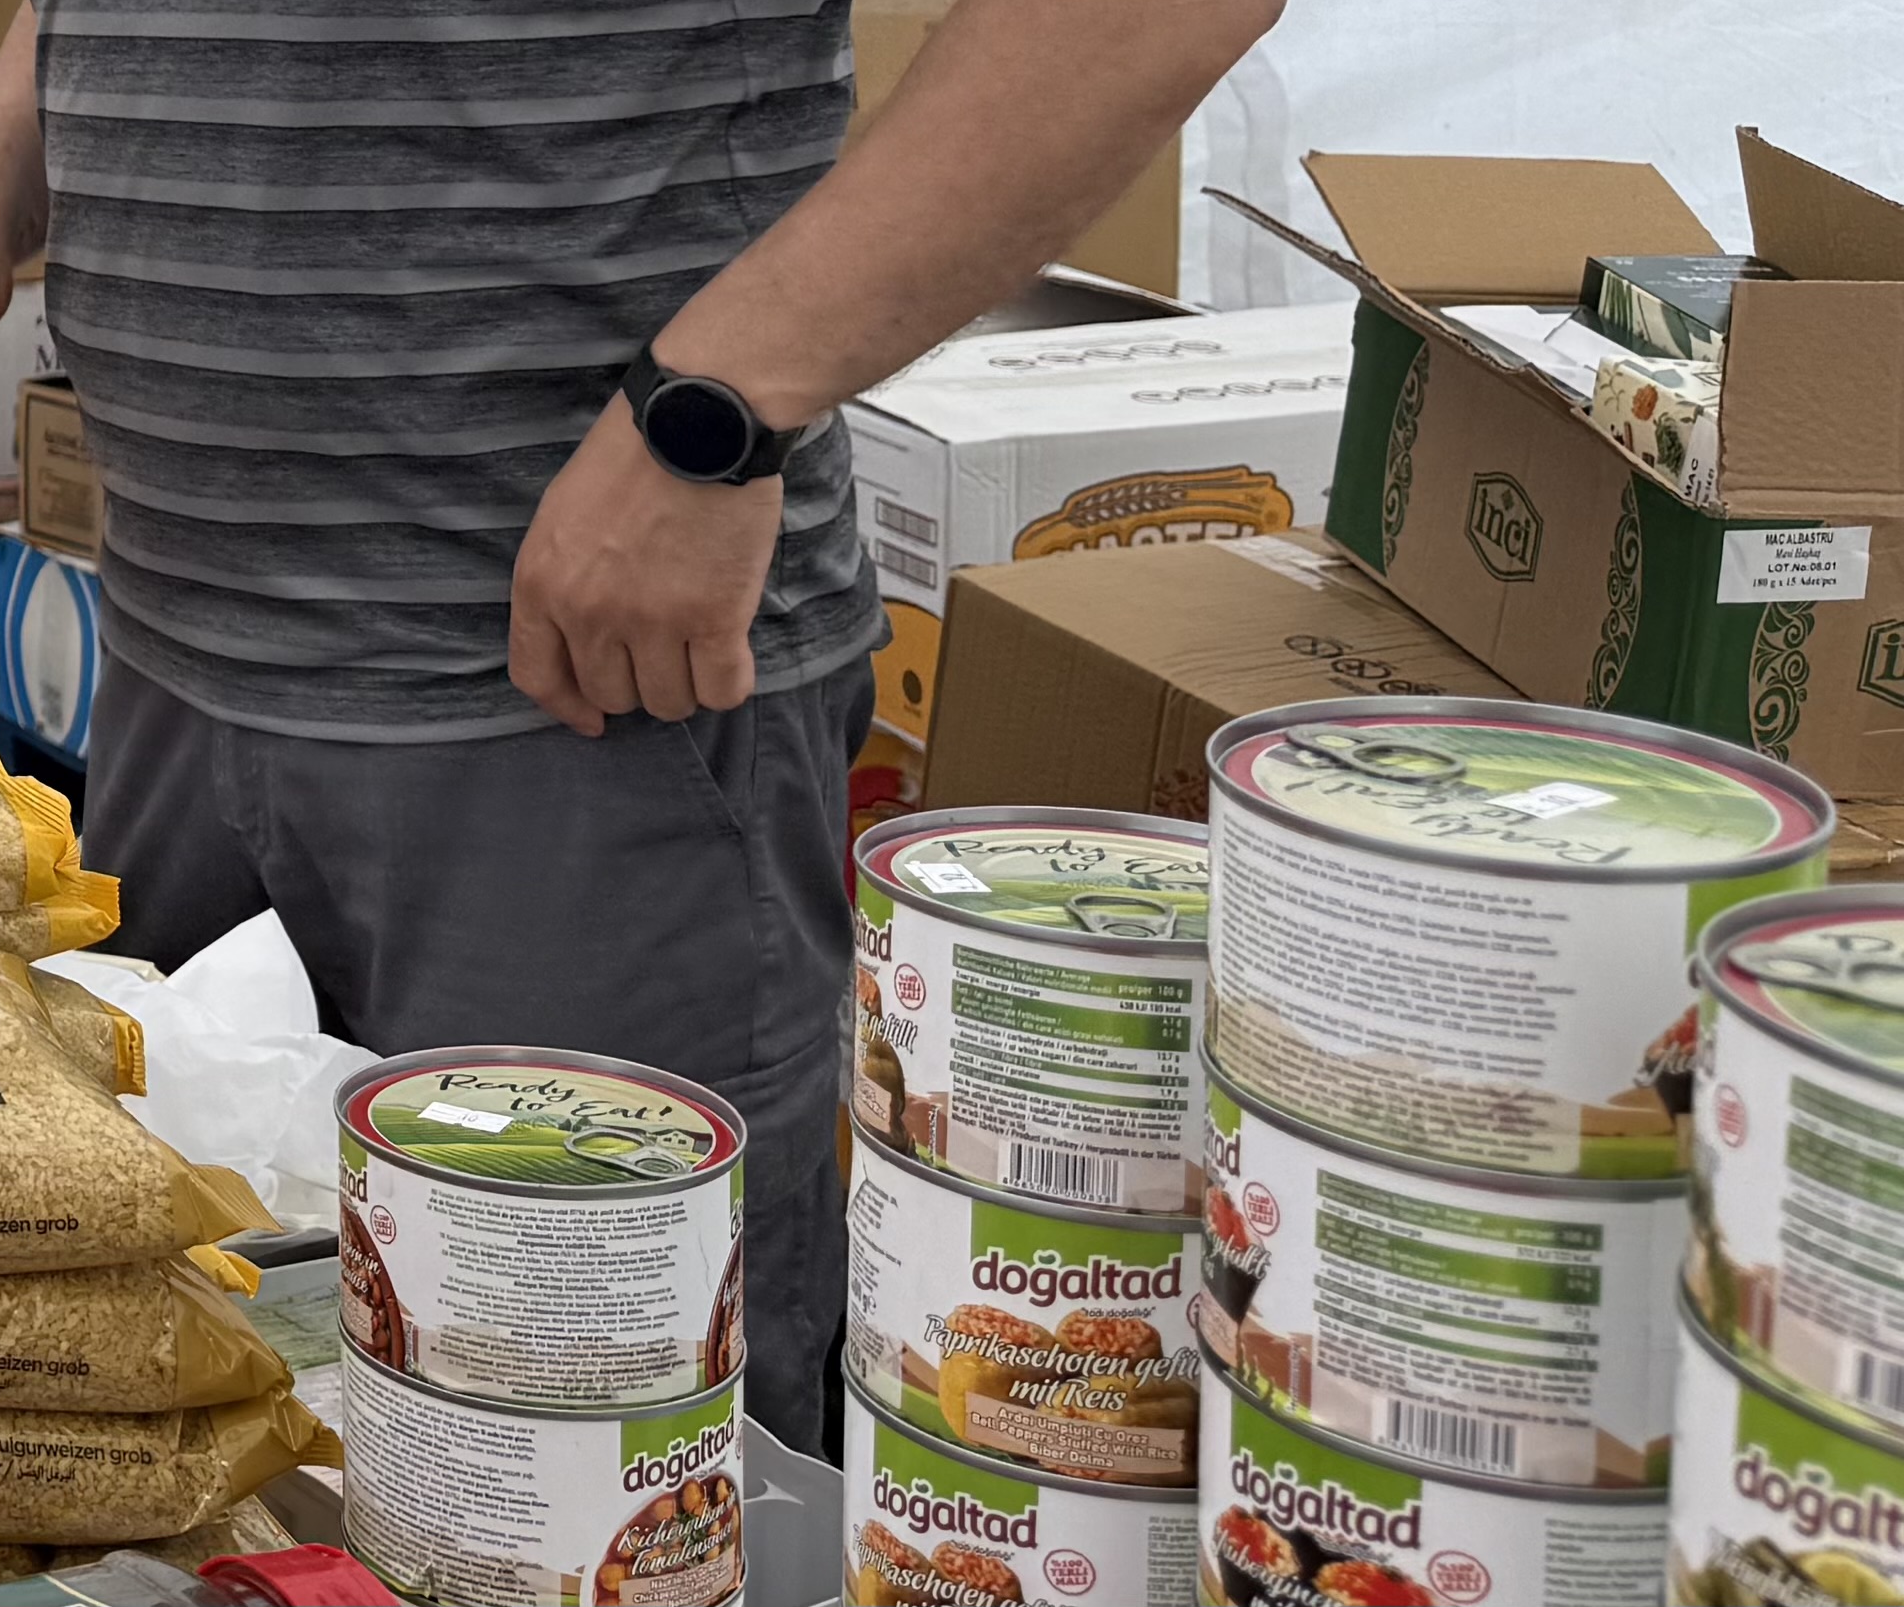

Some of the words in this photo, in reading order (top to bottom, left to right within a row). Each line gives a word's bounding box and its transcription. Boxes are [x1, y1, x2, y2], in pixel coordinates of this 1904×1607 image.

[1765, 533, 1785, 545] MAC
[1787, 531, 1834, 544] ALBASTRU
[934, 839, 1106, 863] Ready
[1049, 858, 1095, 873] to
[435, 1074, 575, 1102] Ready
[510, 1097, 543, 1111] to
[571, 1100, 673, 1123] Eat!
[35, 1214, 79, 1234] grob
[972, 1251, 1183, 1307] doğaltad
[924, 1314, 1129, 1379] Paprikaschoten
[47, 1357, 91, 1376] grob
[1008, 1377, 1060, 1408] mit
[1063, 1377, 1127, 1411] Reis
[109, 1447, 153, 1466] grob
[623, 1406, 735, 1493] doğaltad
[1069, 1450, 1115, 1468] Dolma
[1147, 1444, 1178, 1460] Rice
[873, 1473, 1038, 1549] doğaltad
[1231, 1454, 1423, 1550] doğaltad
